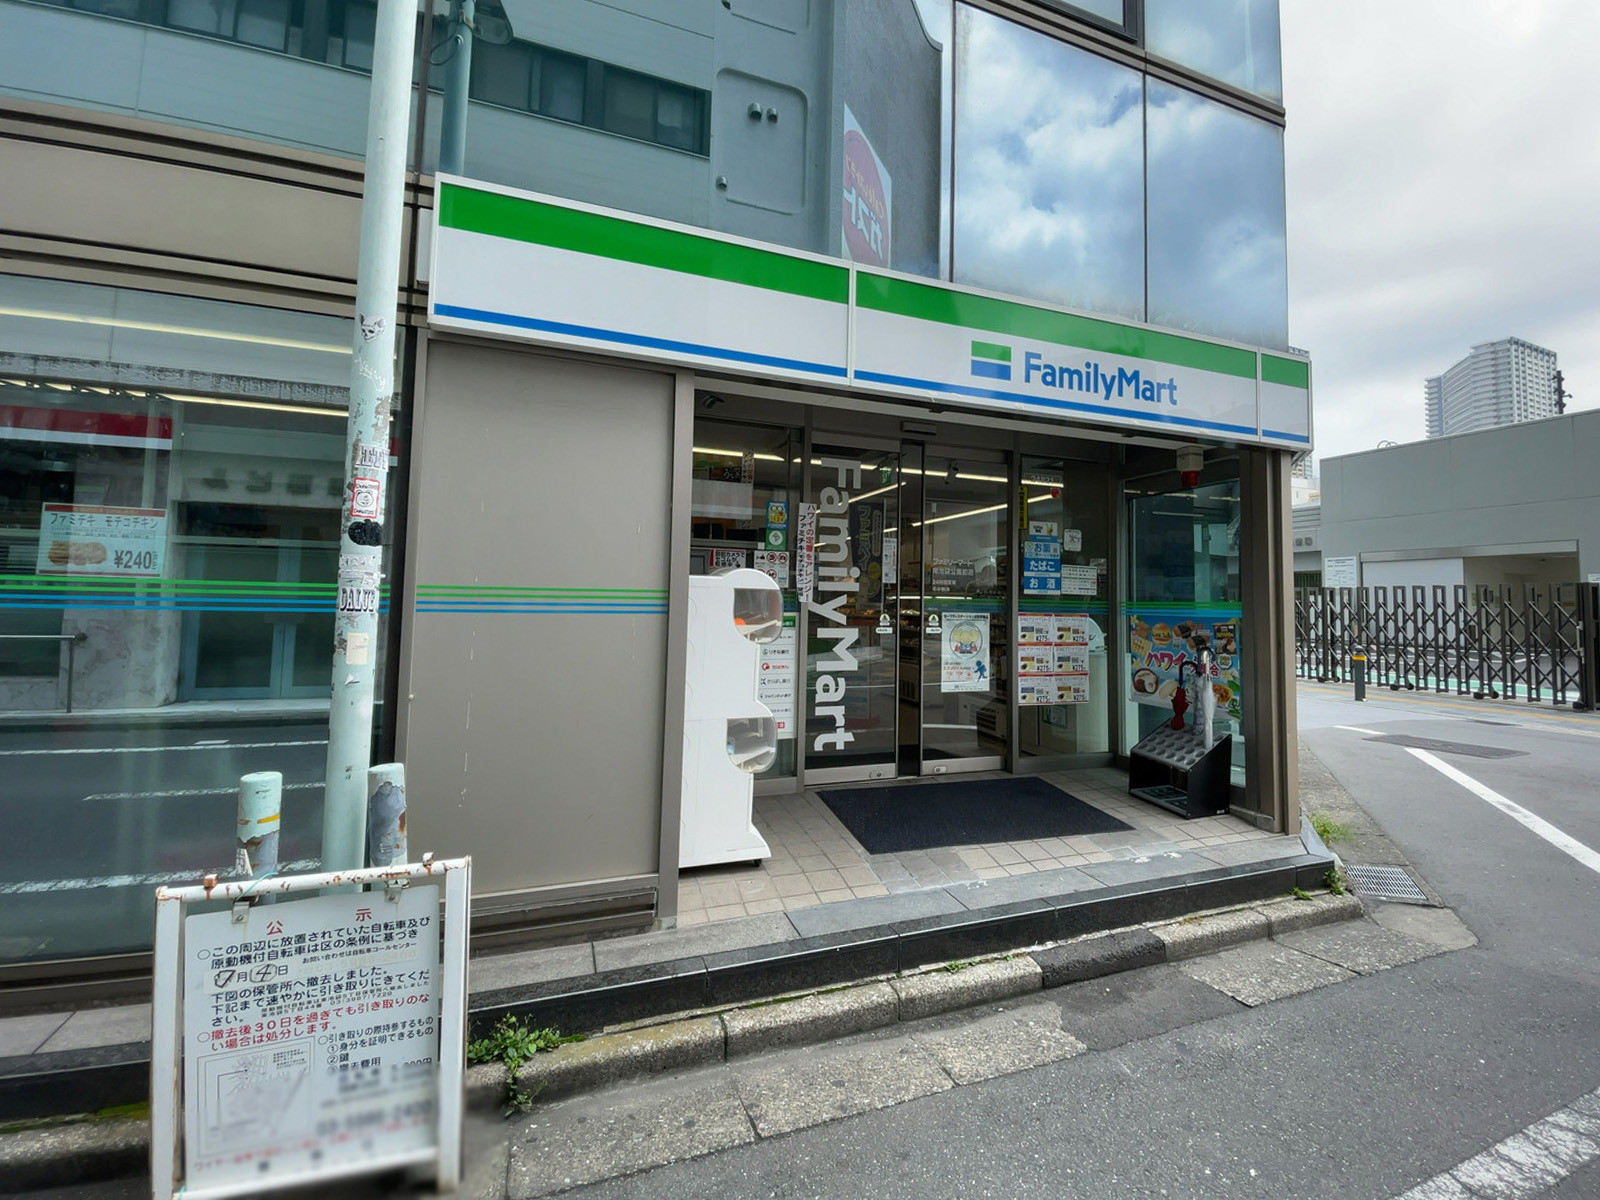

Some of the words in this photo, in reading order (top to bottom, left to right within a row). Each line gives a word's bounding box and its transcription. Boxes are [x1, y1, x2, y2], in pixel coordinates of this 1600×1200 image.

[1024, 350, 1178, 406] FamilyMart
[50, 512, 95, 526] ファミチキ
[105, 515, 159, 529] モチコチキン
[114, 549, 152, 570] ¥240
[933, 558, 973, 566] ファミリーマート
[1029, 560, 1055, 571] たばこ
[808, 457, 862, 752] FamilyMart
[1144, 650, 1187, 672] ハワイ
[266, 920, 284, 936] 公
[355, 907, 372, 922] 示
[210, 929, 418, 970] 原動機付自転車は区の条例に基づき
[212, 916, 431, 958] この周辺に放置されていた自転車及び
[302, 942, 417, 964] お問い合わせは自転車コールセンター
[211, 966, 388, 1005] 下図の保管所へ撤去しました。
[211, 969, 430, 1016] 下記まで速やかに引き取りにきてくだ
[211, 1013, 244, 1027] さい。
[211, 1023, 337, 1052] い場合は処分します。
